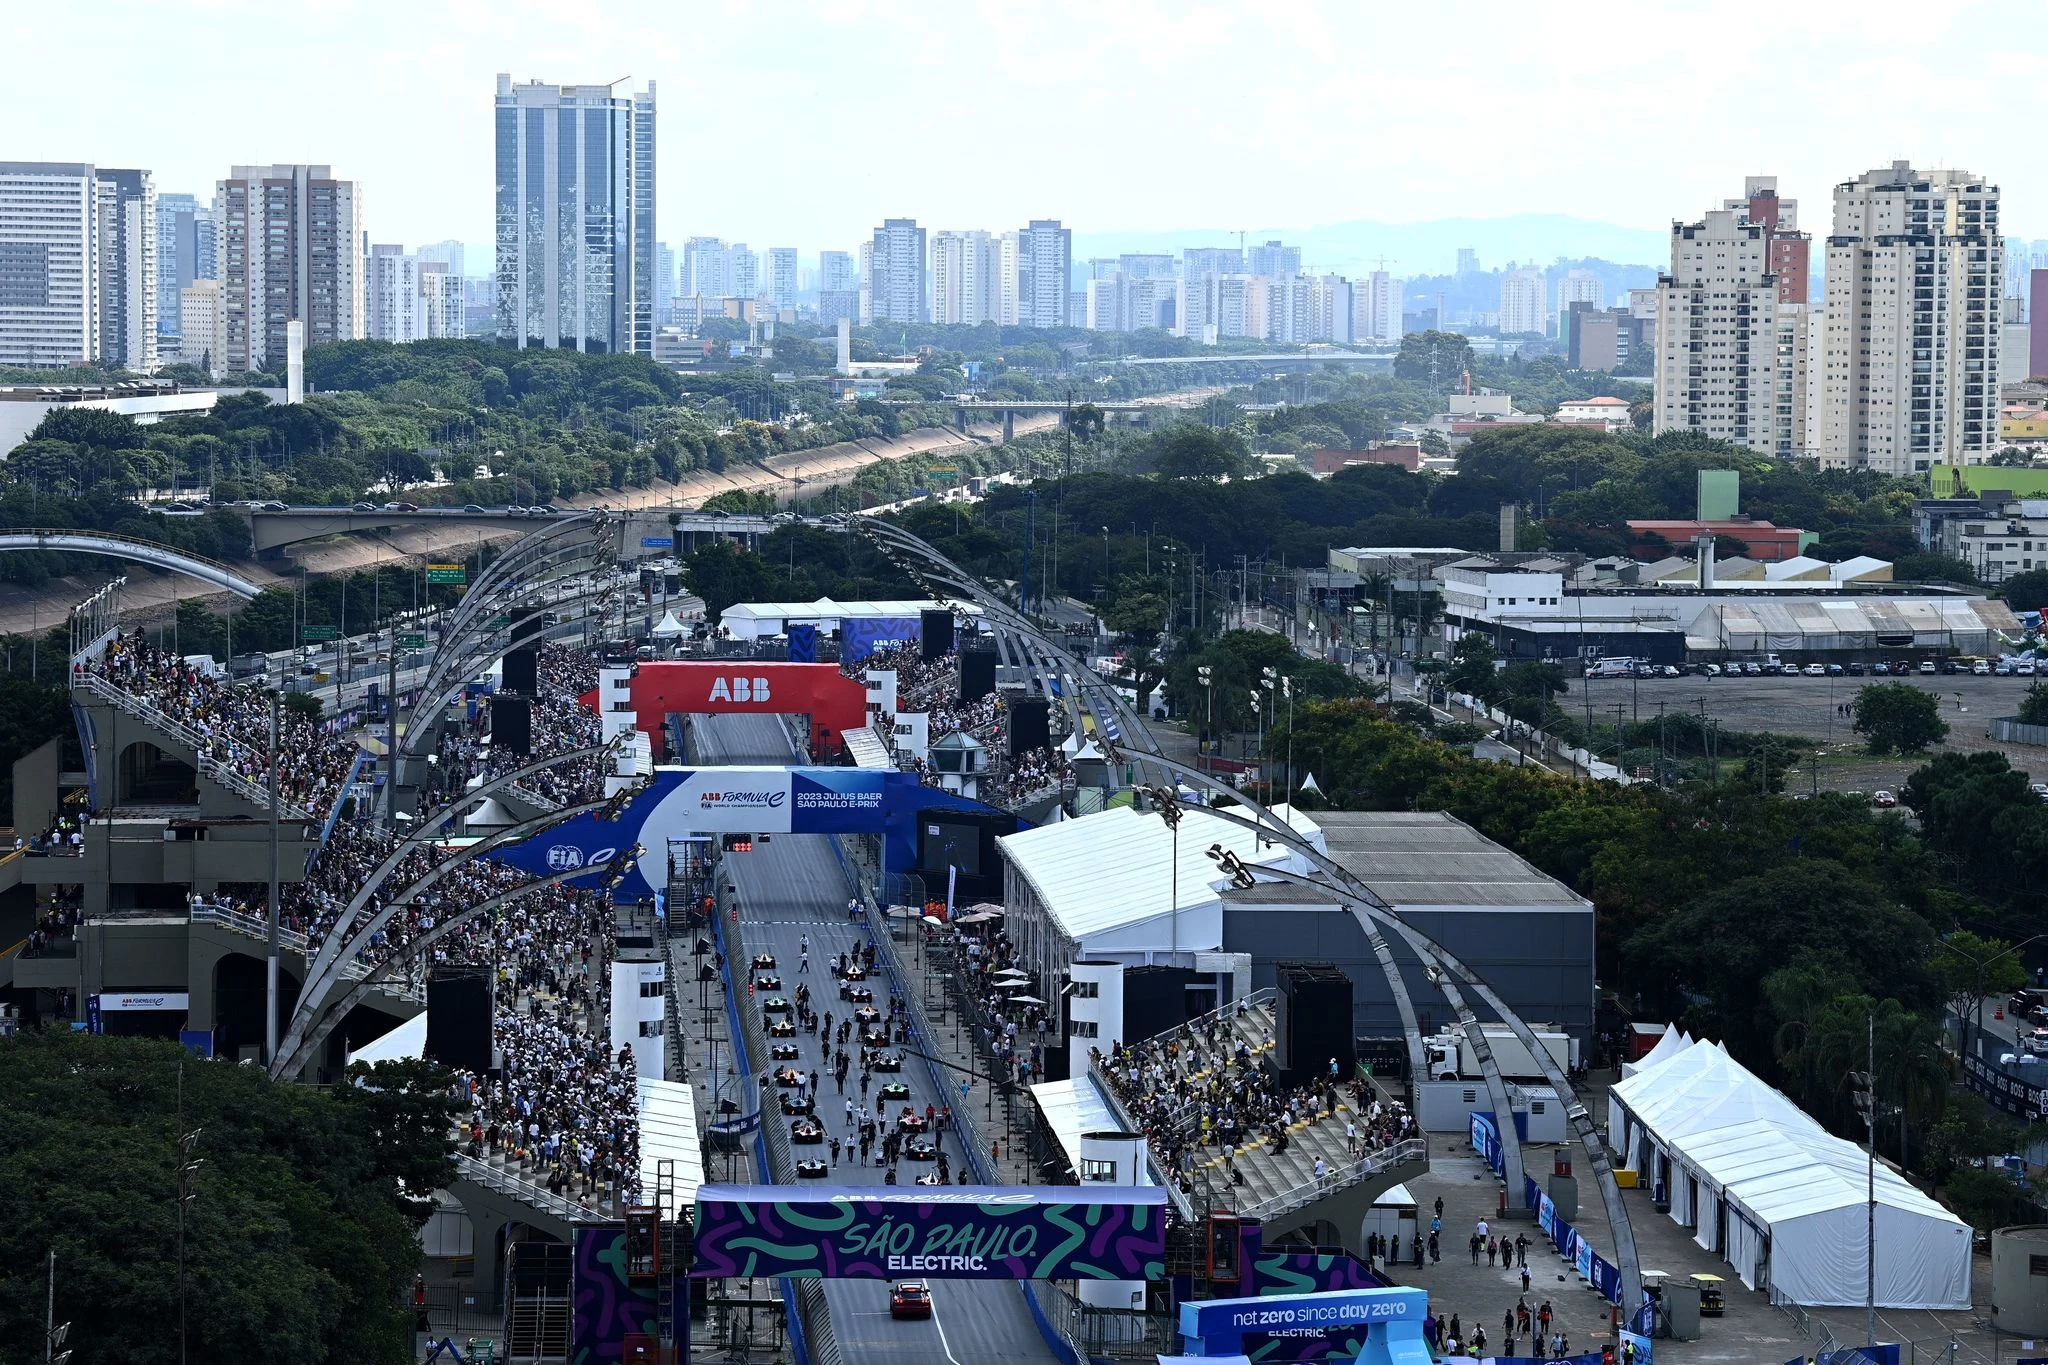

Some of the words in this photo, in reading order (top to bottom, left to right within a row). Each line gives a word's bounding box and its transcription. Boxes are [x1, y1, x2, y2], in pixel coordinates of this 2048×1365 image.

[708, 677, 771, 702] ABB
[701, 793, 721, 801] ABB
[722, 791, 769, 802] FORMULA
[797, 792, 823, 801] 2023
[824, 792, 856, 801] JULIUS
[857, 792, 882, 801] BAER
[817, 800, 848, 808] PAULO
[849, 800, 879, 808] E-PRIX
[2010, 1081, 2024, 1099] BOSS
[839, 1214, 915, 1259] SÃO
[888, 1255, 988, 1271] ELECTRIC.
[1233, 1310, 1258, 1328] net
[1297, 1306, 1337, 1322] since
[1339, 1303, 1370, 1319] day
